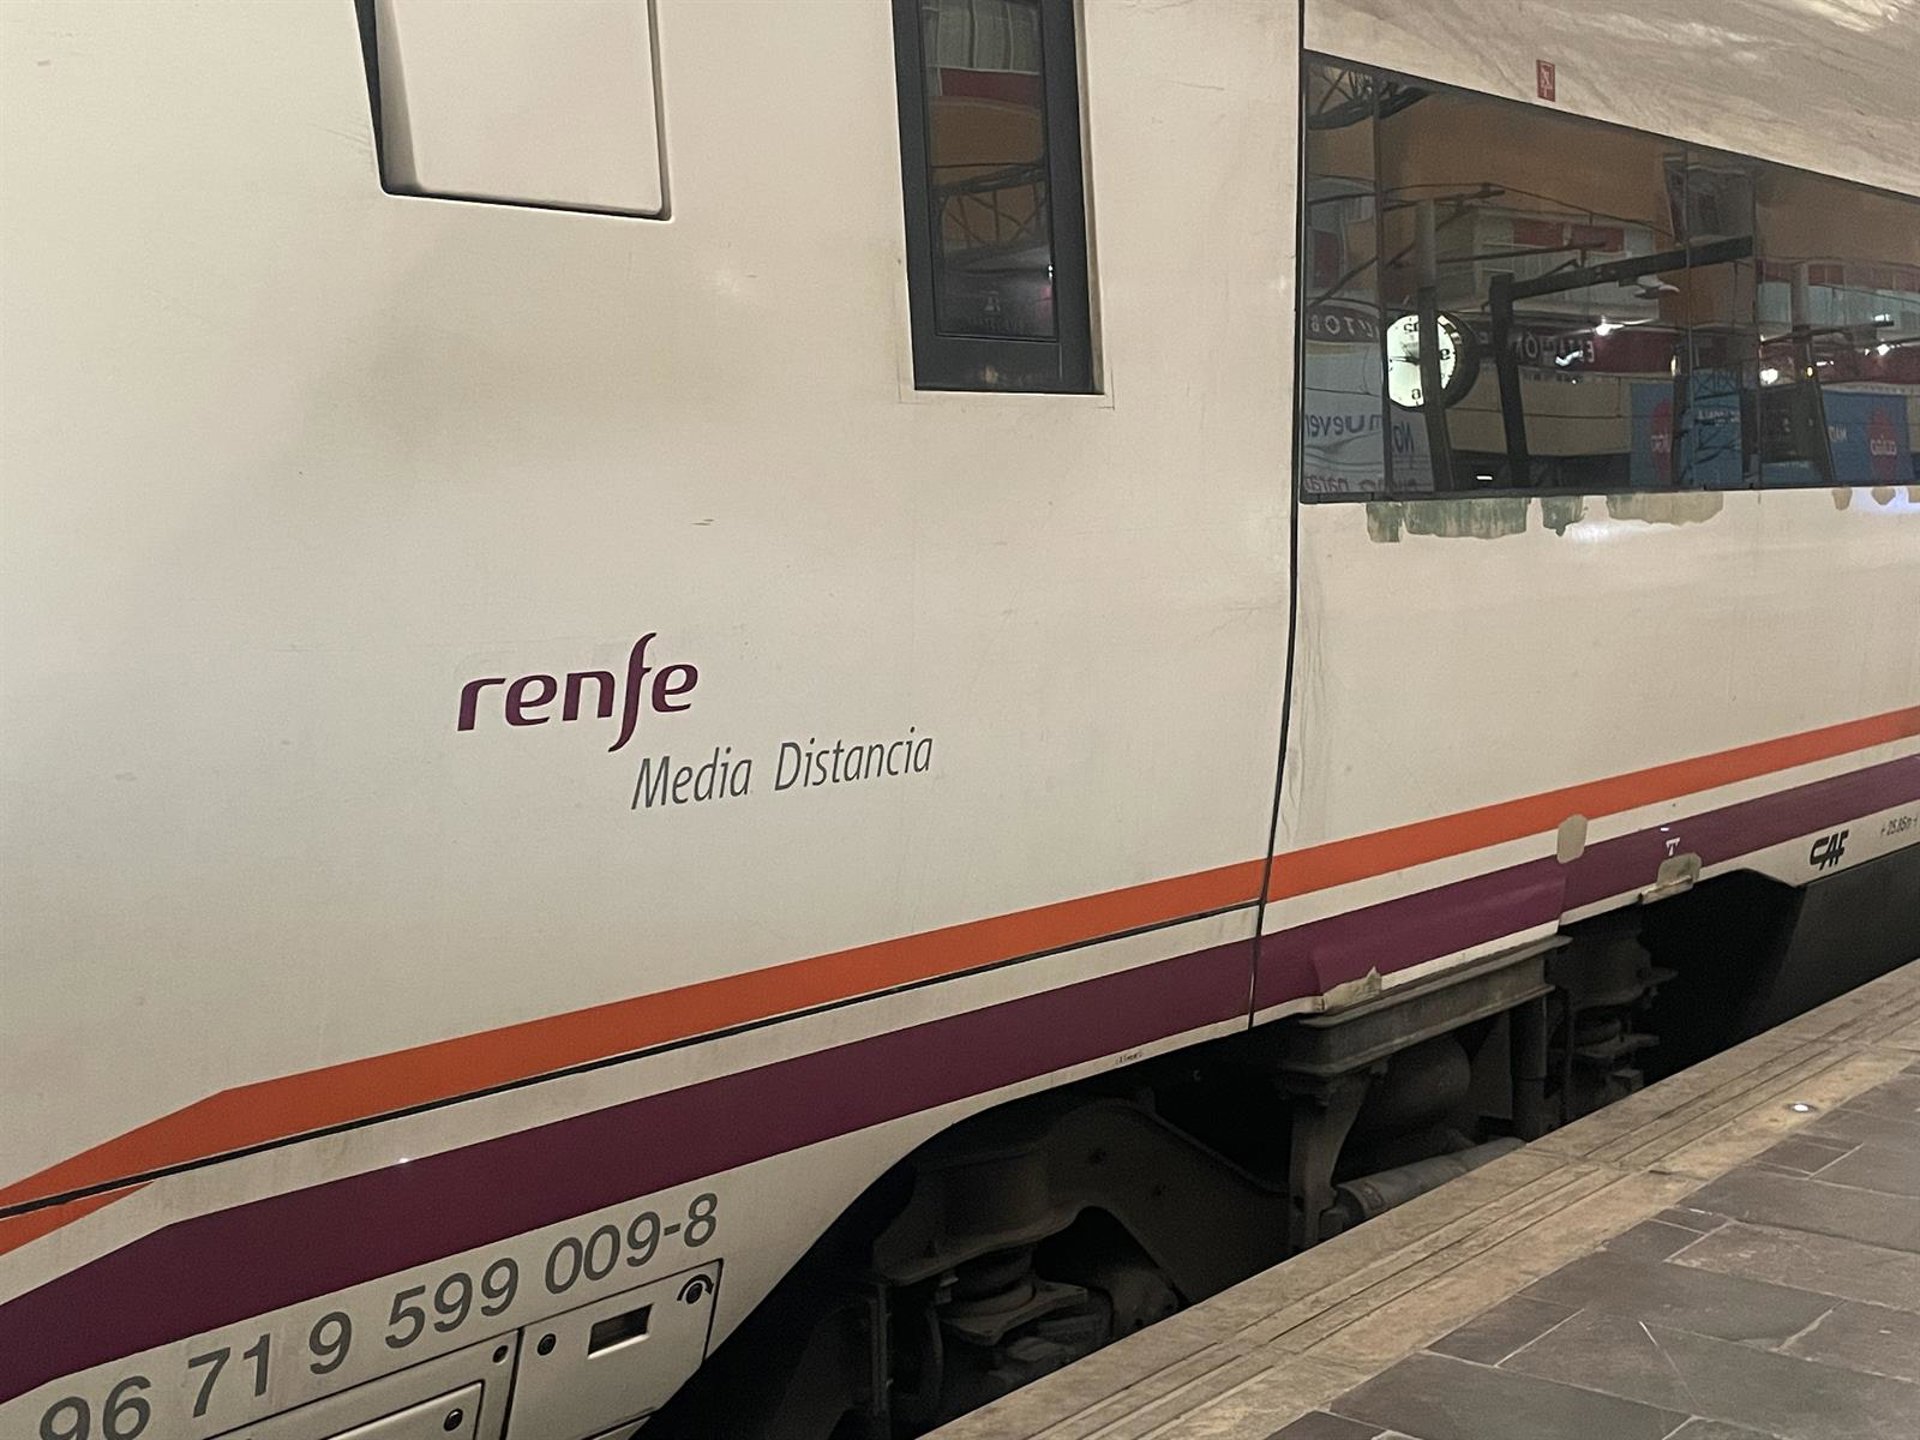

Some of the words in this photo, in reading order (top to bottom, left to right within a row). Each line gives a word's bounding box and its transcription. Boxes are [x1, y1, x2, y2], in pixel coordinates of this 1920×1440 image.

[457, 632, 698, 752] renfe
[631, 747, 752, 810] Media
[774, 726, 933, 792] Distancia
[39, 1375, 152, 1440] 96
[187, 1333, 271, 1418] 71
[308, 1311, 353, 1376] 9
[385, 1257, 519, 1351] 599
[544, 1193, 718, 1295] 009-8
